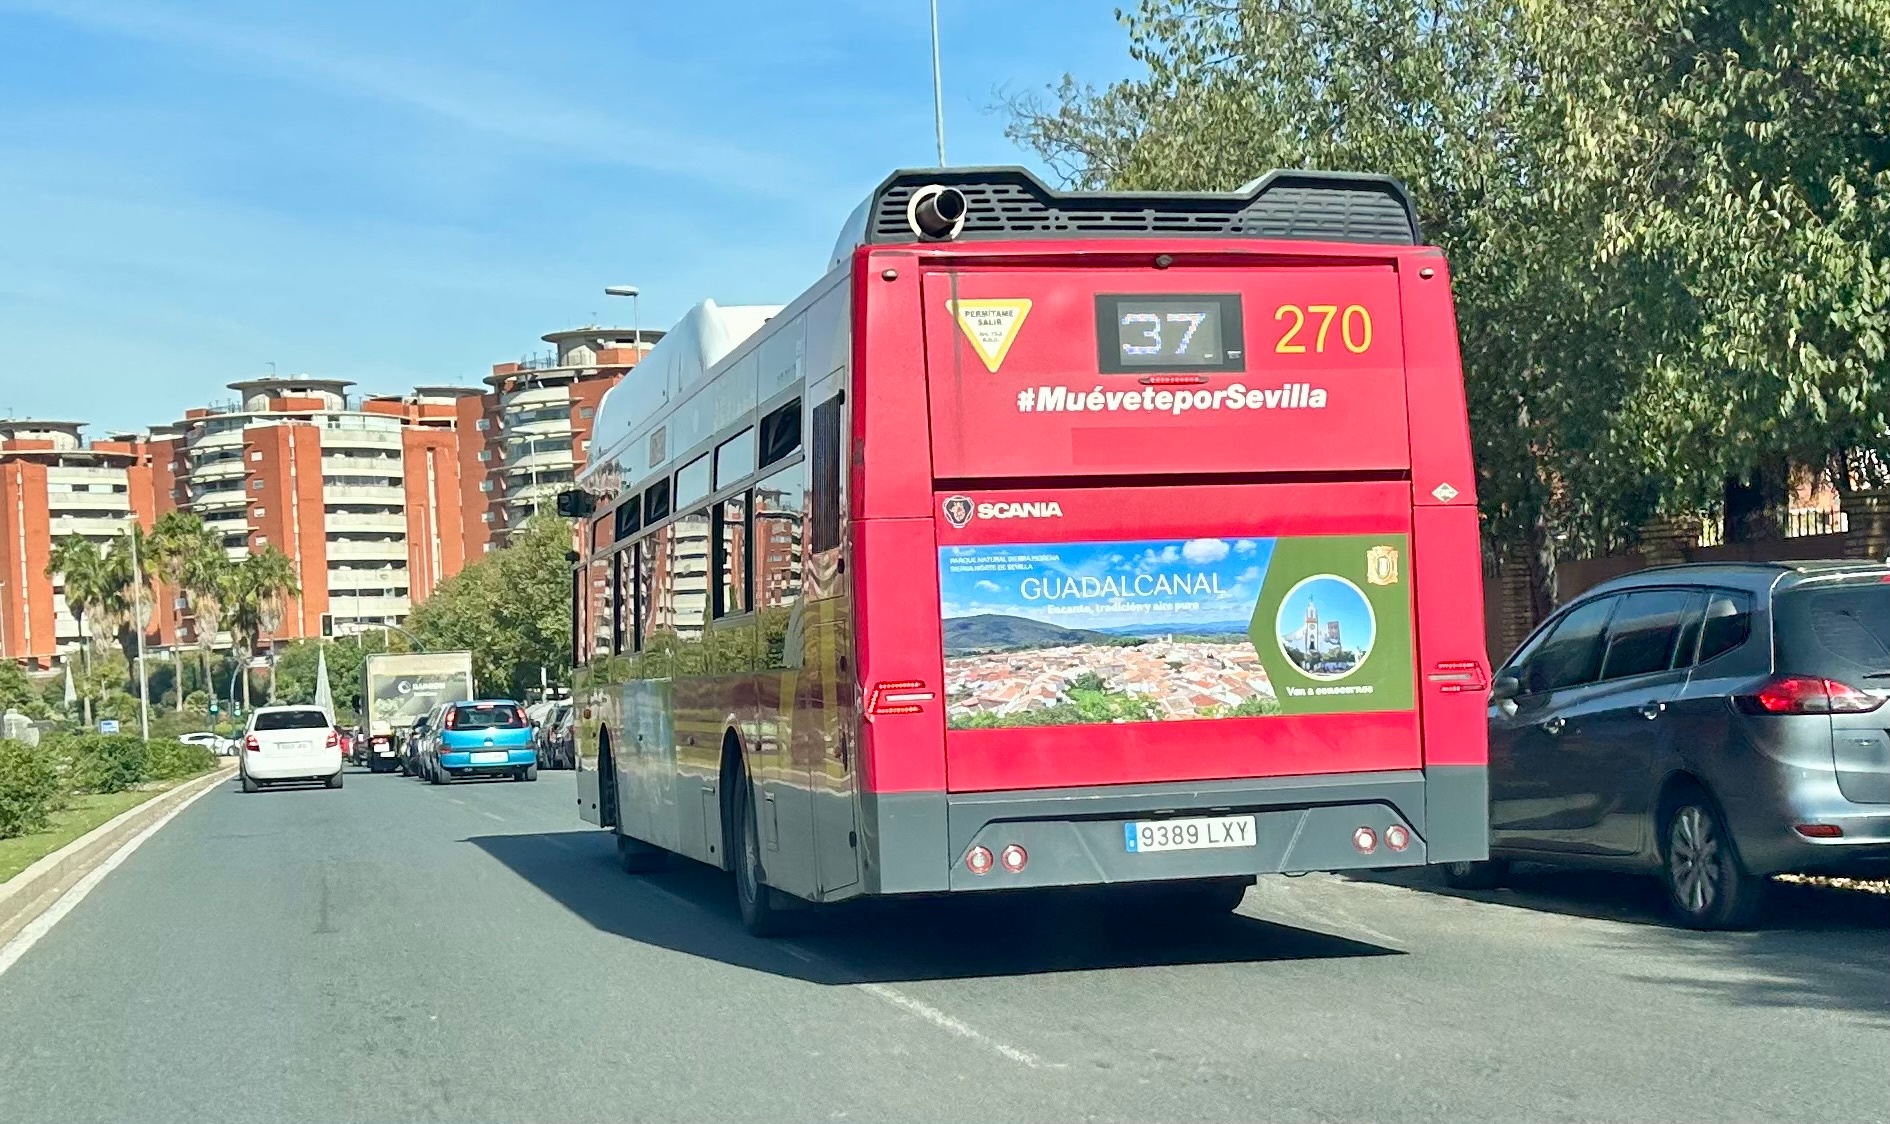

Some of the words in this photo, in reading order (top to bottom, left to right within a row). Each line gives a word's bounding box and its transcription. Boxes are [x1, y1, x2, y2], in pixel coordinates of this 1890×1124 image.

[977, 318, 1003, 326] SALIR
[1274, 304, 1373, 355] 270
[1121, 312, 1206, 354] 37
[1017, 384, 1328, 415] #MuéveteporSevilla
[977, 501, 1064, 519] SCANIA
[977, 555, 1007, 564] NATURAL
[1007, 562, 1034, 571] SEVILLA
[1020, 573, 1227, 600] GUADALCANAL
[1095, 601, 1143, 613] tradición
[1152, 600, 1174, 611] aire
[1174, 601, 1200, 612] puro
[1285, 686, 1307, 697] Ven
[1141, 824, 1199, 847] 9389
[1207, 820, 1248, 844] LXY
